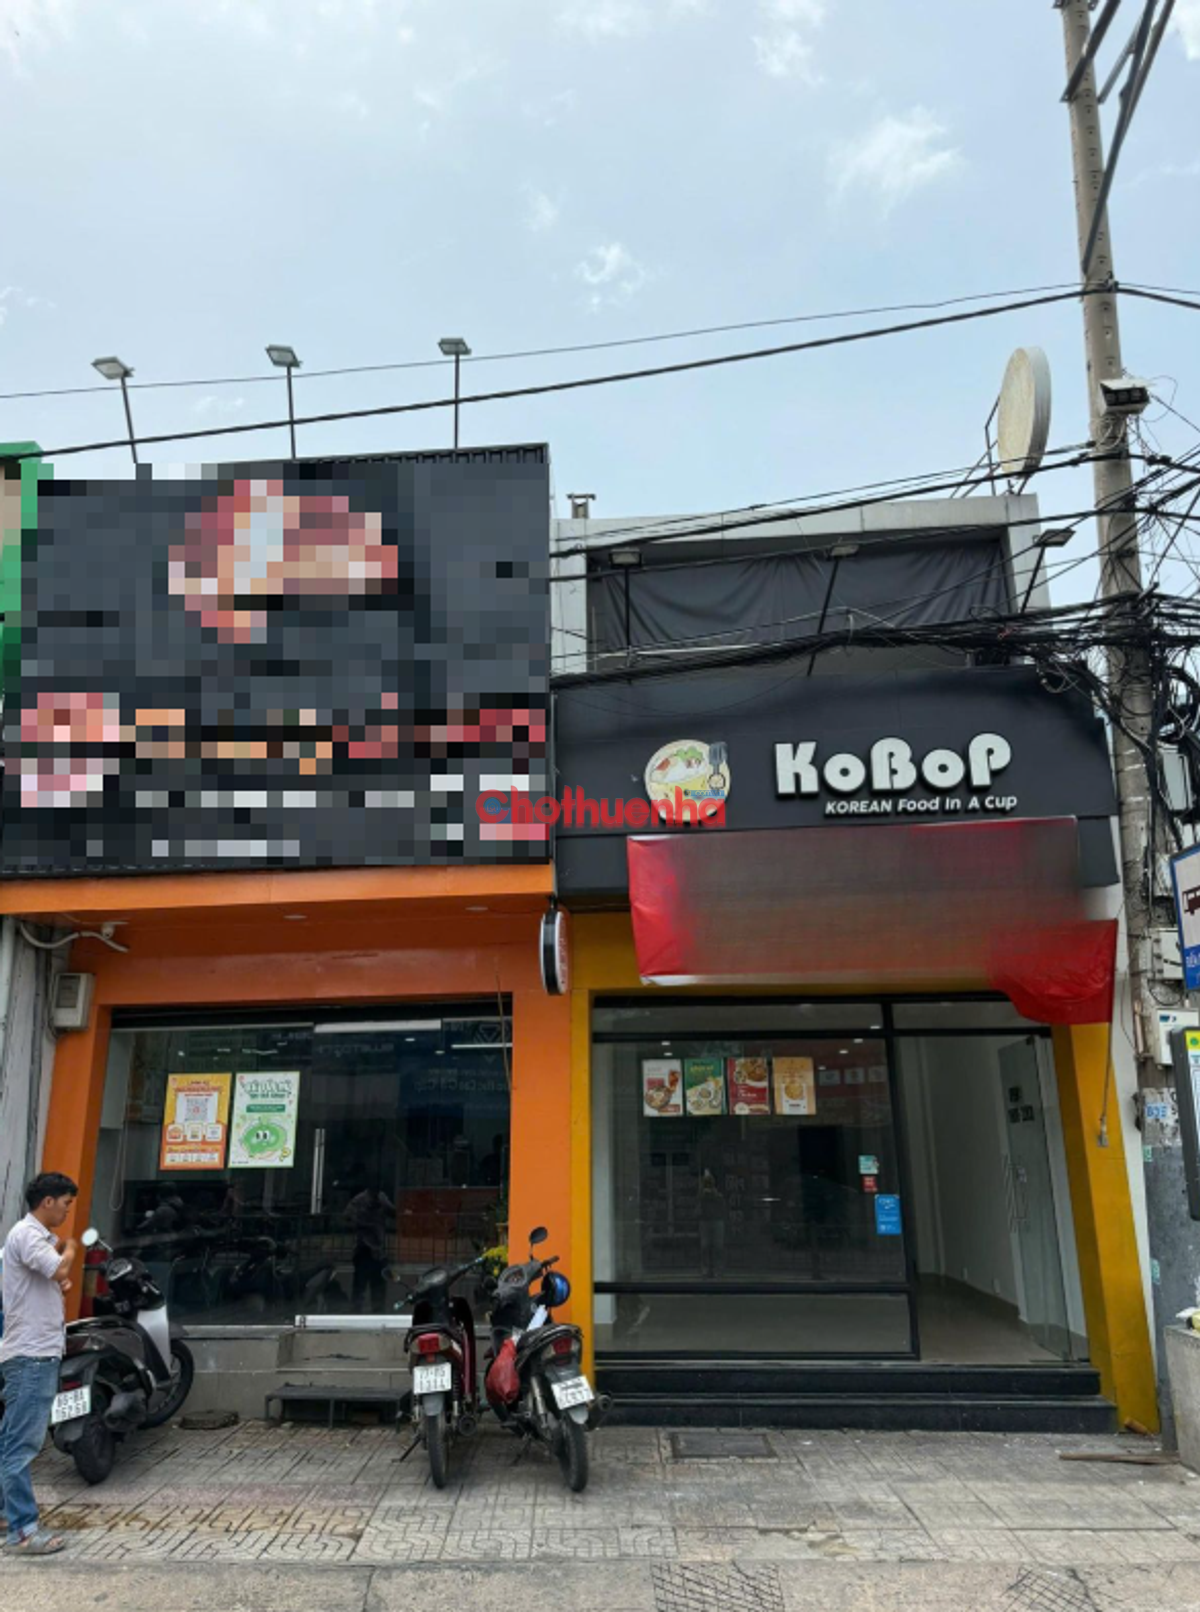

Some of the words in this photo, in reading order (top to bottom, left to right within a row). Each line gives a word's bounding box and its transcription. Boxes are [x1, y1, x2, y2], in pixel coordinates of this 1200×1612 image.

[825, 800, 892, 814] KOREAN
[897, 797, 939, 811] Food
[968, 796, 981, 809] A
[985, 795, 1017, 811] Cup
